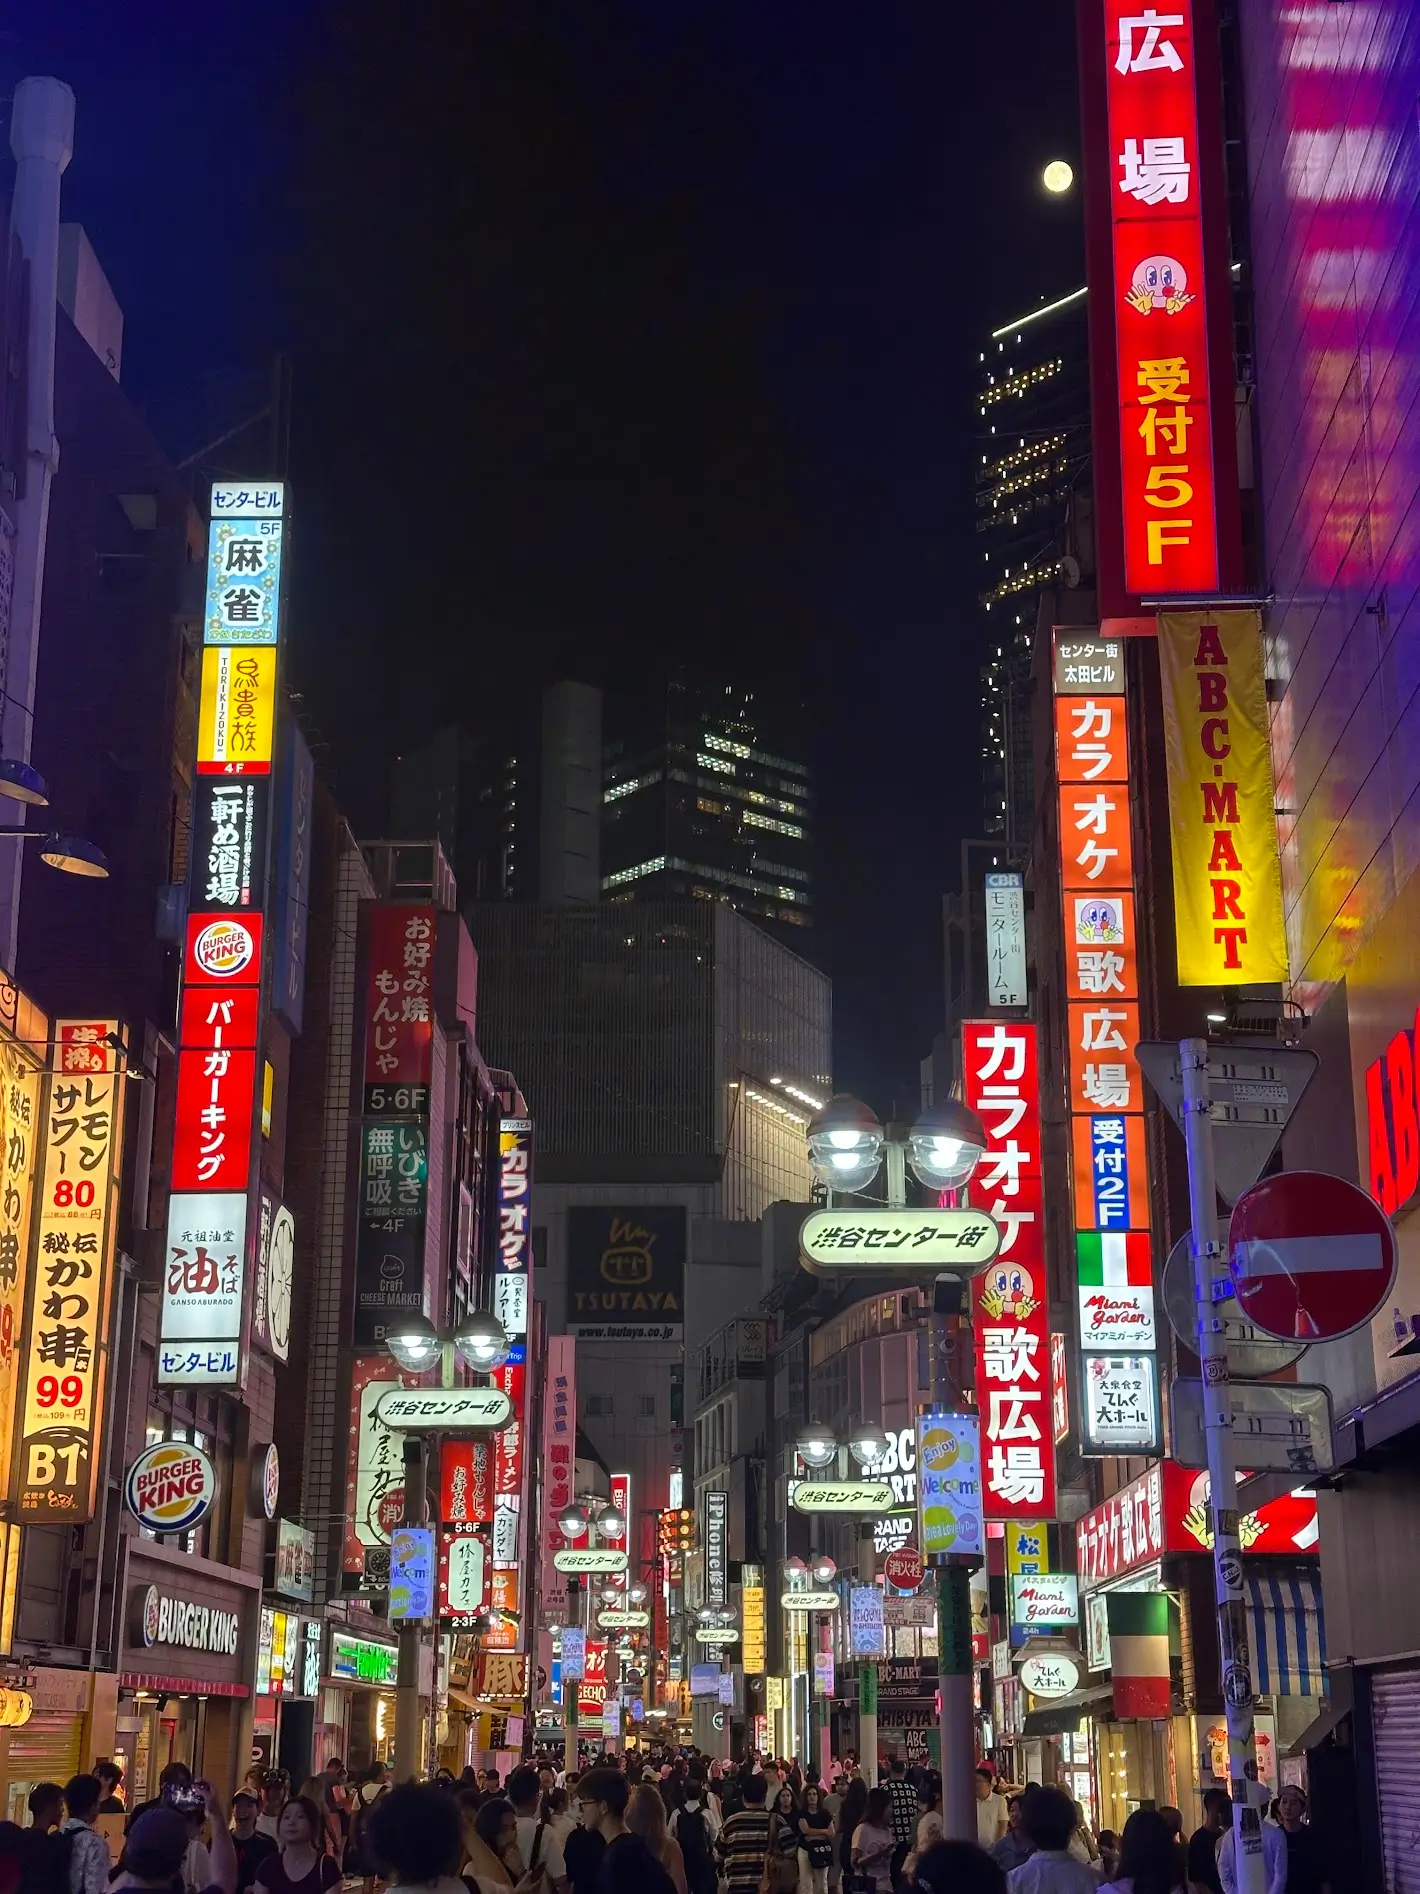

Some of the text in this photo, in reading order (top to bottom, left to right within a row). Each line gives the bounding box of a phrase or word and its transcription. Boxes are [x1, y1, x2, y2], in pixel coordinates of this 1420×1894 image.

[1114, 9, 1191, 205] 広場
[1136, 356, 1194, 565] 受付5F
[214, 491, 281, 508] センタービル
[260, 523, 280, 535] 5F
[223, 538, 264, 622] 麻雀
[1059, 643, 1118, 658] センター街
[1064, 665, 1116, 683] 太田ビル
[217, 657, 228, 748] TORIKIZOKU
[224, 763, 244, 773] 4F
[1193, 625, 1248, 969] ABC-MART
[205, 784, 243, 906] 一軒め酒場
[1071, 701, 1130, 1108] カラオケ 歌広場
[1008, 891, 1021, 953] 渋谷センター街
[203, 931, 244, 951] BURGER
[991, 890, 1009, 989] モニタールーム
[203, 941, 246, 964] KING
[400, 916, 432, 1023] お好み焼
[1000, 994, 1017, 1004] 5F
[372, 969, 399, 1075] もんじゃ
[197, 998, 235, 1181] バーガーキング
[50, 1084, 82, 1175] サワー
[79, 1078, 109, 1173] レモン
[366, 1127, 395, 1205] 無呼吸
[397, 1127, 425, 1204] いびき
[1092, 1119, 1127, 1227] 受付2F
[53, 1180, 95, 1208] 80
[364, 1206, 422, 1217] ご相談ください
[500, 1147, 528, 1264] カラオケ
[181, 1230, 236, 1243] 元祖油堂
[382, 1219, 404, 1233] 4F
[811, 1226, 989, 1248] 渋谷センター街
[42, 1231, 99, 1254] 秘伝
[975, 1026, 1046, 1504] カラオケ 歌広場
[380, 1279, 403, 1293] Craft
[360, 1293, 421, 1307] CHEESE MARKET
[575, 1291, 679, 1310] TSUTAYA
[1084, 1295, 1140, 1310] Miami
[36, 1257, 94, 1369] かわ串
[578, 1326, 674, 1339] www.tsutaya.co.jp
[1083, 1331, 1153, 1341] マイアミガーデン
[162, 1352, 236, 1373] センタービル
[36, 1375, 83, 1408] 99
[1100, 1380, 1142, 1390] 大衆食堂
[386, 1401, 502, 1416] 渋谷センター街
[1102, 1392, 1139, 1407] てんぐ
[1096, 1406, 1148, 1423] 大ホール
[922, 1437, 957, 1465] Enjoy
[27, 1443, 81, 1486] B1
[137, 1458, 202, 1492] BURGER
[472, 1443, 488, 1521] 築地もんじゃ
[922, 1476, 979, 1495] Welcome
[138, 1473, 205, 1516] KING
[799, 1490, 890, 1503] 渋谷センター街
[1079, 1472, 1162, 1588] カラオケ歌広場
[557, 1556, 625, 1566] 渋谷センター街
[889, 1560, 922, 1577] 消火栓
[784, 1596, 836, 1605] 渋谷センター街
[1017, 1588, 1065, 1601] Miami
[158, 1597, 209, 1649] BURGER
[208, 1608, 239, 1656] KING
[1034, 1676, 1066, 1687] 大ホール
[1039, 1667, 1061, 1676] てんぐ
[906, 1731, 927, 1747] ABC
